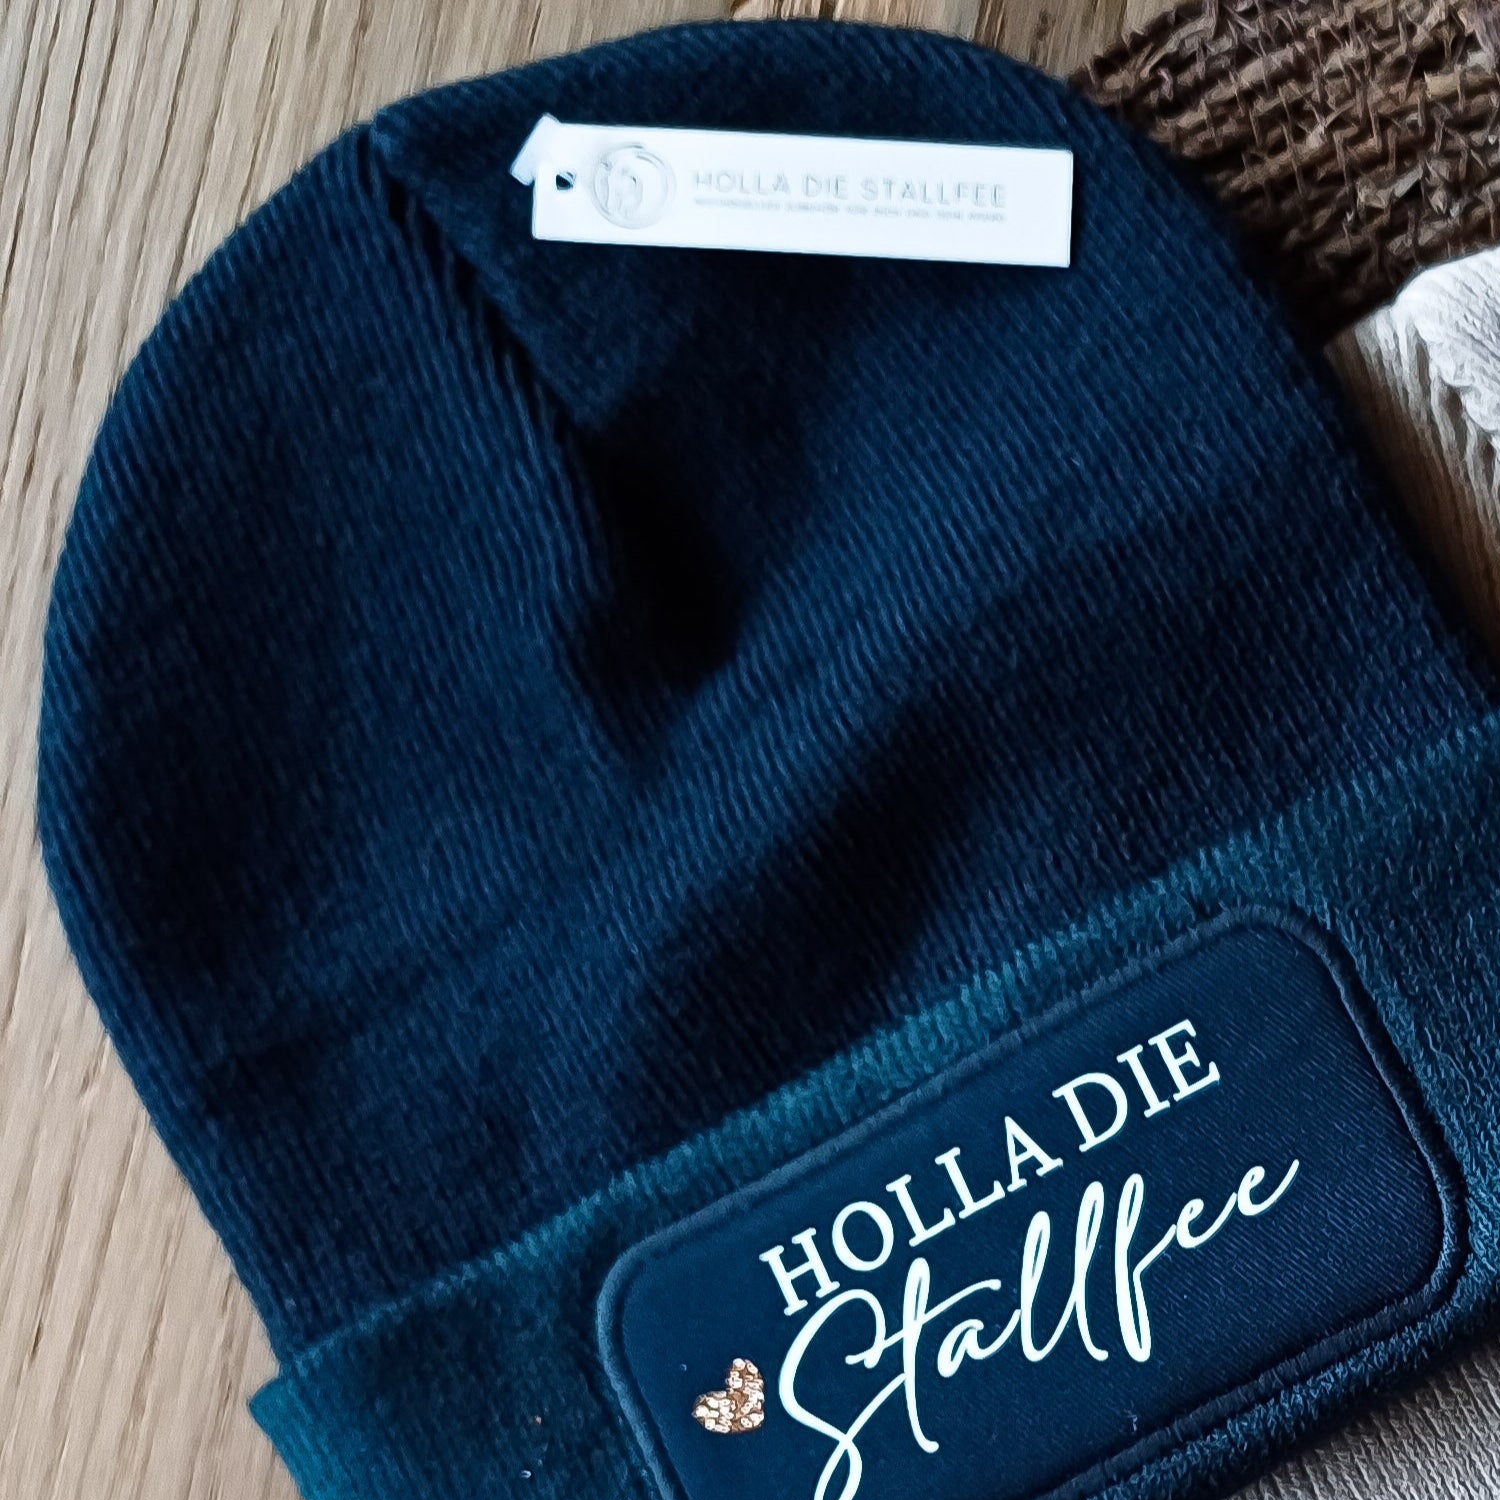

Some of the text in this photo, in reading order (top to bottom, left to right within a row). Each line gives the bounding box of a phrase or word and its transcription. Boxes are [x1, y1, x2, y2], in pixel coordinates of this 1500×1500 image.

[694, 169, 1007, 208] HOLLA DIE STALLFEE
[758, 1018, 1221, 1317] HOLLA DIE
